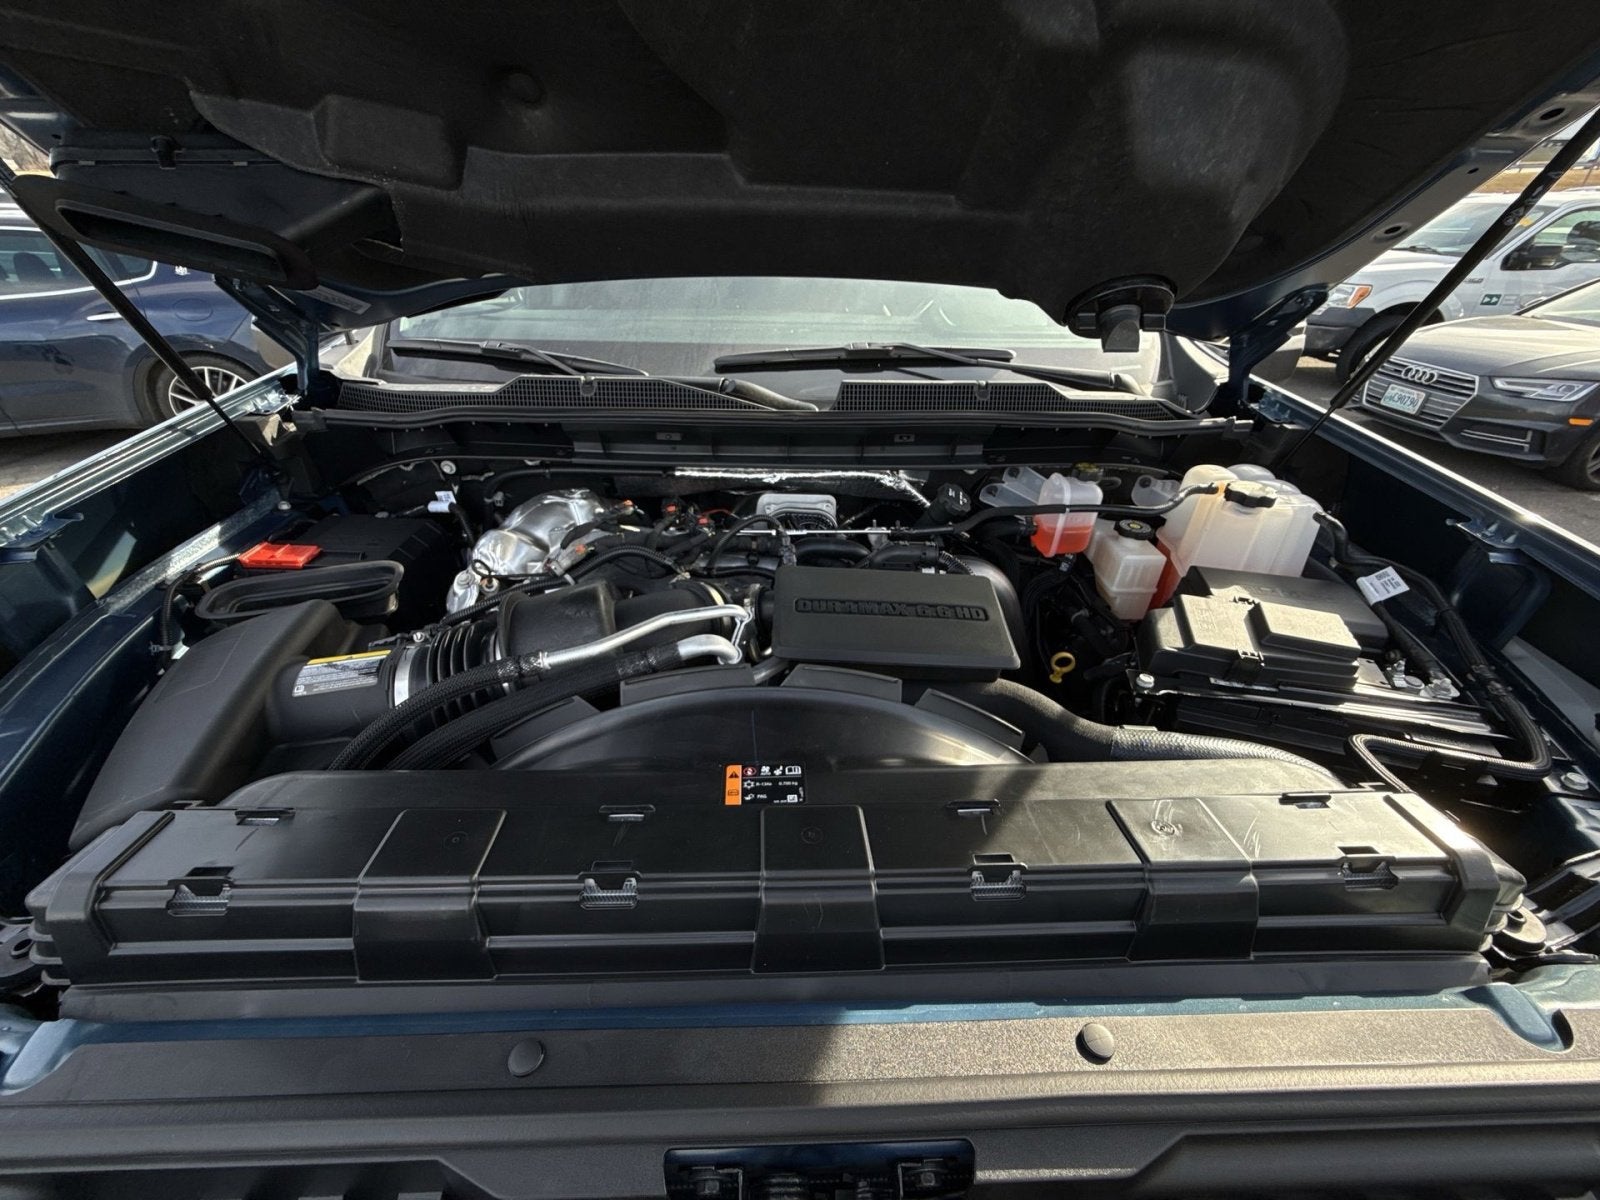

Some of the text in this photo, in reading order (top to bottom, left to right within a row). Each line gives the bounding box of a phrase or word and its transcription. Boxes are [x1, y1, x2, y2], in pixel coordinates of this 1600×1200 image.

[798, 600, 987, 621] DURAMAX 6.6 HD
